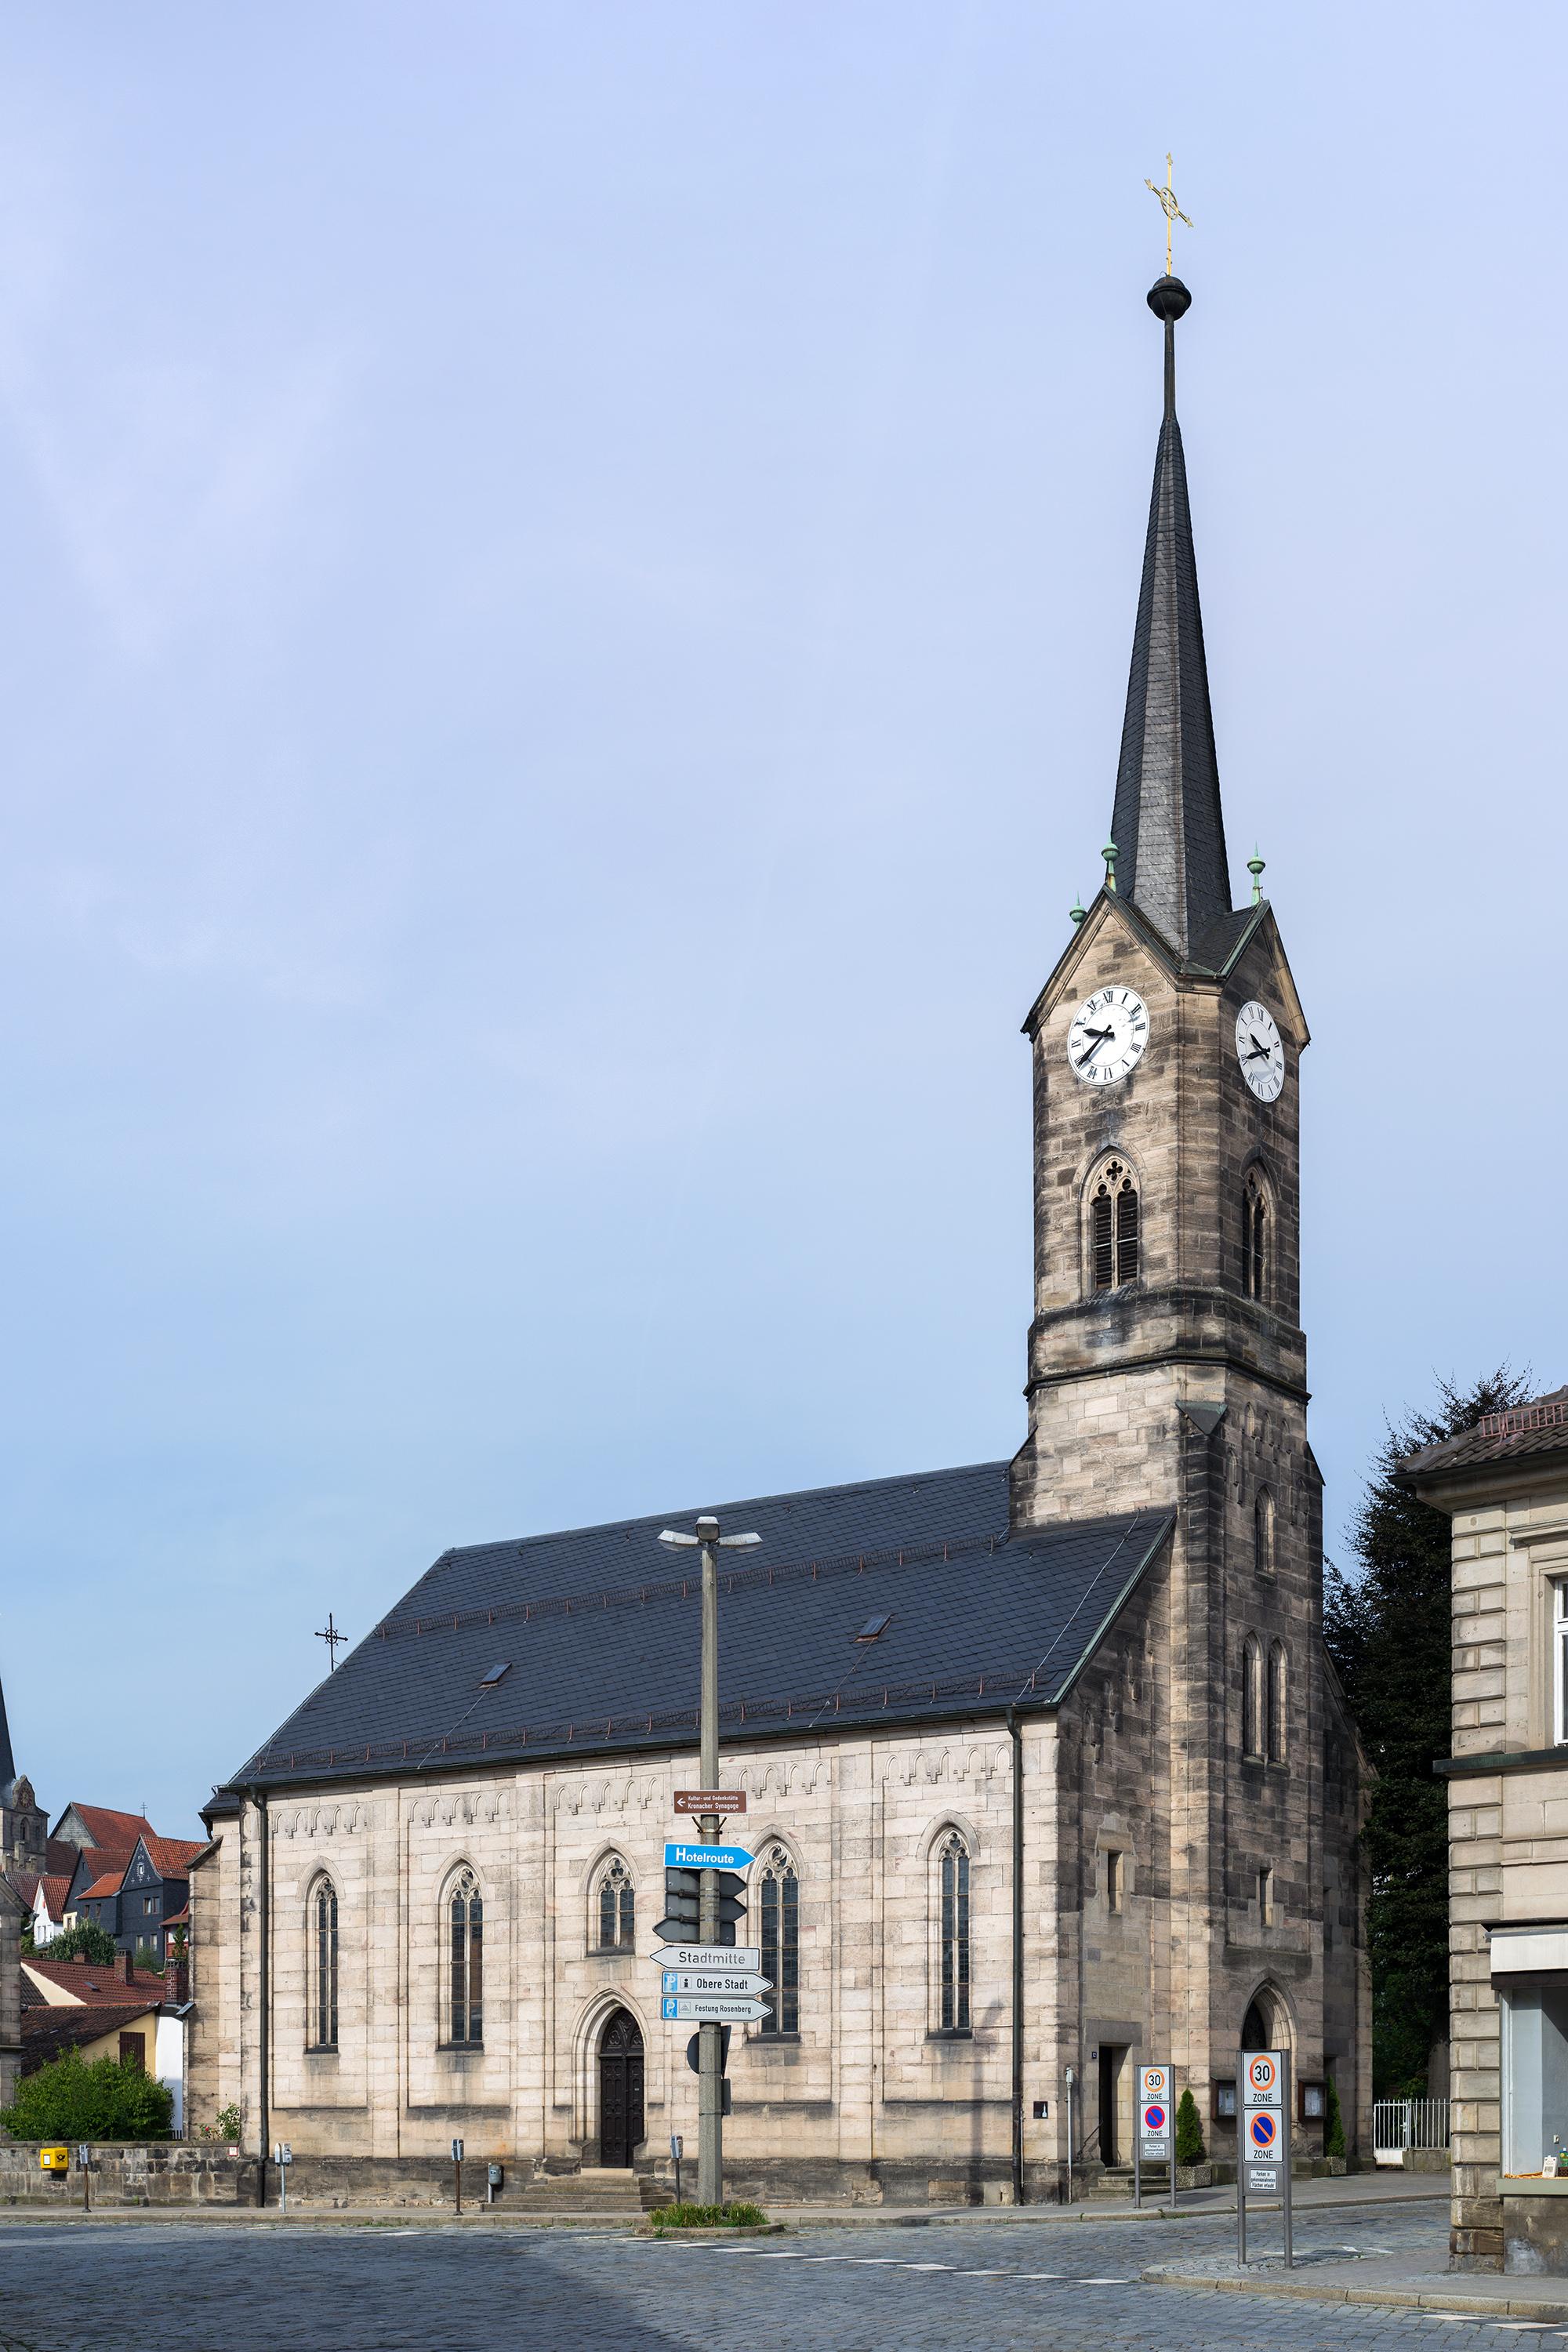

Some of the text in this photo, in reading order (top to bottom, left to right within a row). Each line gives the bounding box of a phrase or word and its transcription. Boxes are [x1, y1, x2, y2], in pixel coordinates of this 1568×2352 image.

[676, 1847, 735, 1864] Hotelroute
[679, 1951, 746, 1965] Stadtmitte
[696, 1978, 748, 1990] Obere Stadt
[695, 2004, 752, 2014] Festung Rosenberg
[1254, 2065, 1270, 2082] 30
[1149, 2074, 1161, 2085] 30
[1253, 2093, 1272, 2102] ZONE
[1254, 2151, 1273, 2159] ZONE
